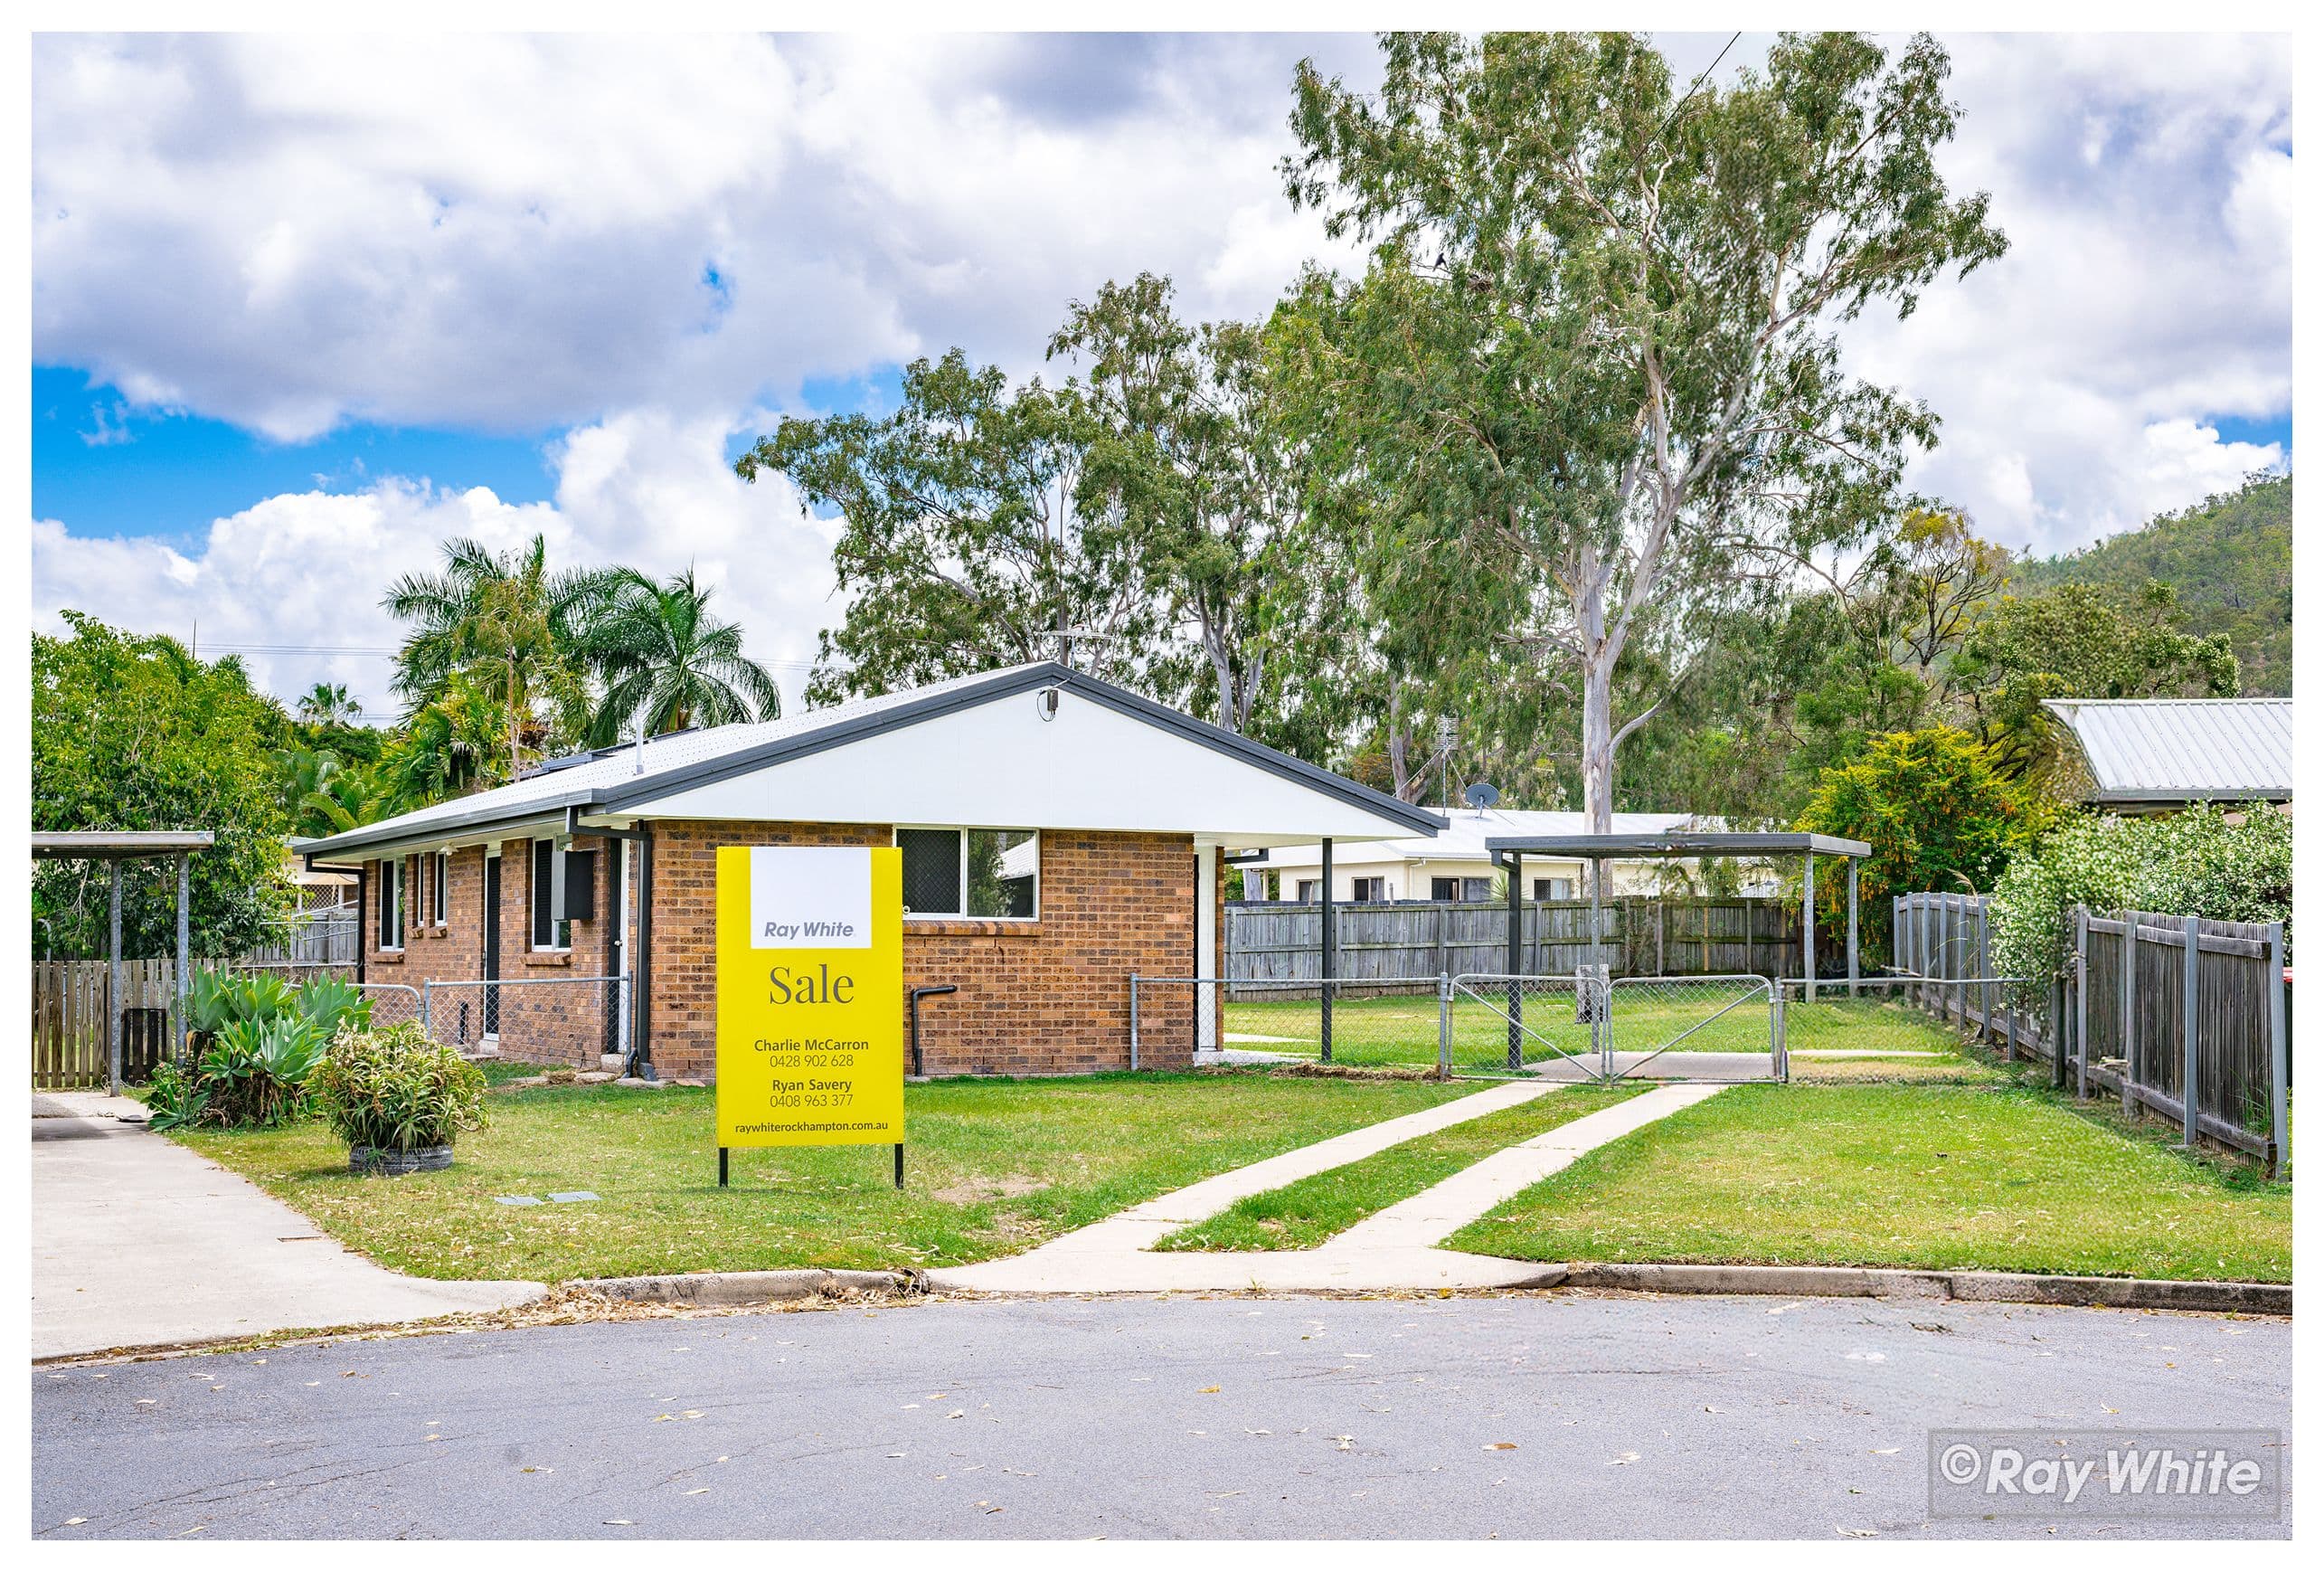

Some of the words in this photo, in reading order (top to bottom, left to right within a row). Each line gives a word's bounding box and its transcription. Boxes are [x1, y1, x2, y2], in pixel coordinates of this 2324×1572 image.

[764, 922, 800, 941] Ray
[803, 922, 855, 937] White
[770, 963, 855, 1005] Sale
[754, 1038, 801, 1052] Charlie
[805, 1039, 869, 1051] McCarron
[770, 1055, 801, 1068] 0428
[804, 1054, 827, 1067] 902
[830, 1054, 854, 1067] 628
[772, 1079, 805, 1094] Ryan
[808, 1078, 853, 1094] Savery
[770, 1094, 801, 1108] 0408
[804, 1094, 827, 1107] 963
[831, 1094, 854, 1107] 377
[734, 1121, 889, 1135] raywhiterockhampton.com.au
